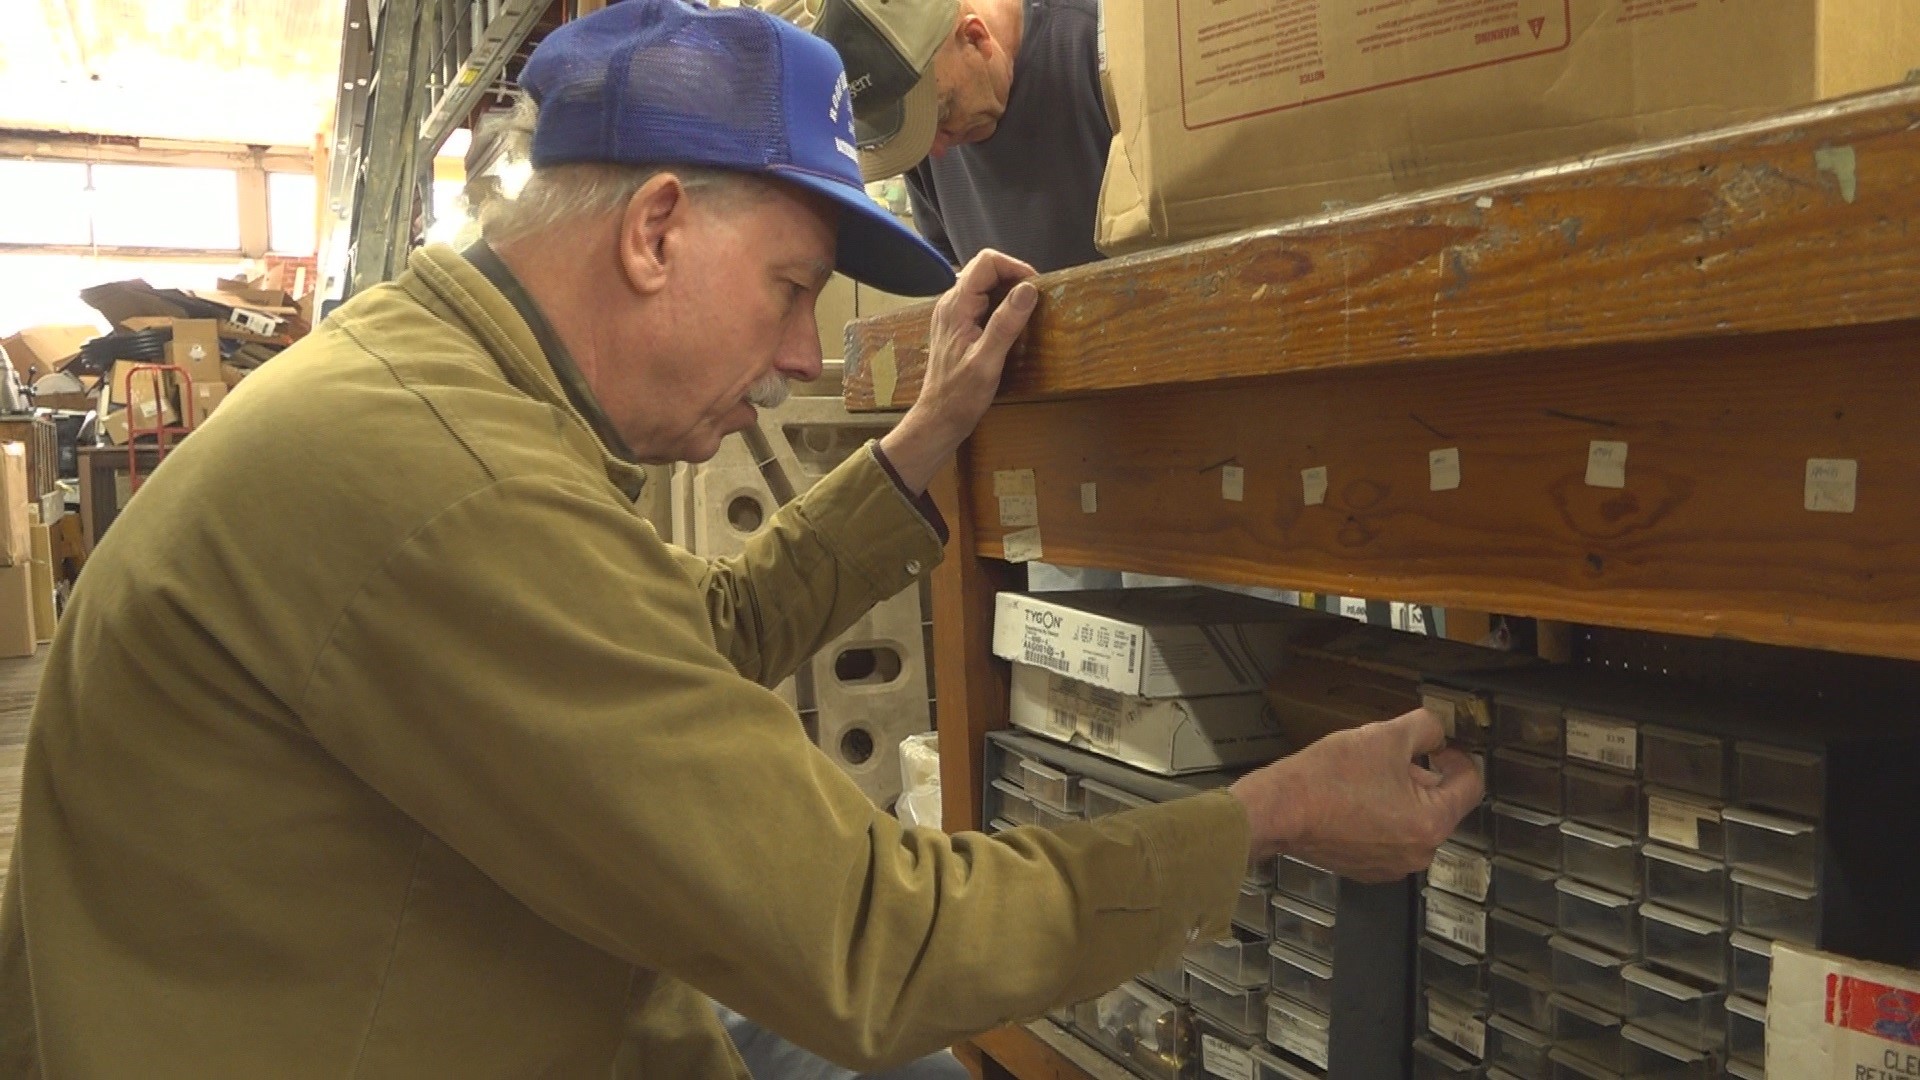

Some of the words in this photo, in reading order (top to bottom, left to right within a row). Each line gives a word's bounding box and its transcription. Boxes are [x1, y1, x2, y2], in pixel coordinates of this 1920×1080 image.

[1474, 24, 1520, 45] WARNING
[1299, 70, 1325, 85] NOTICE
[1884, 1048, 1920, 1076] CLE
